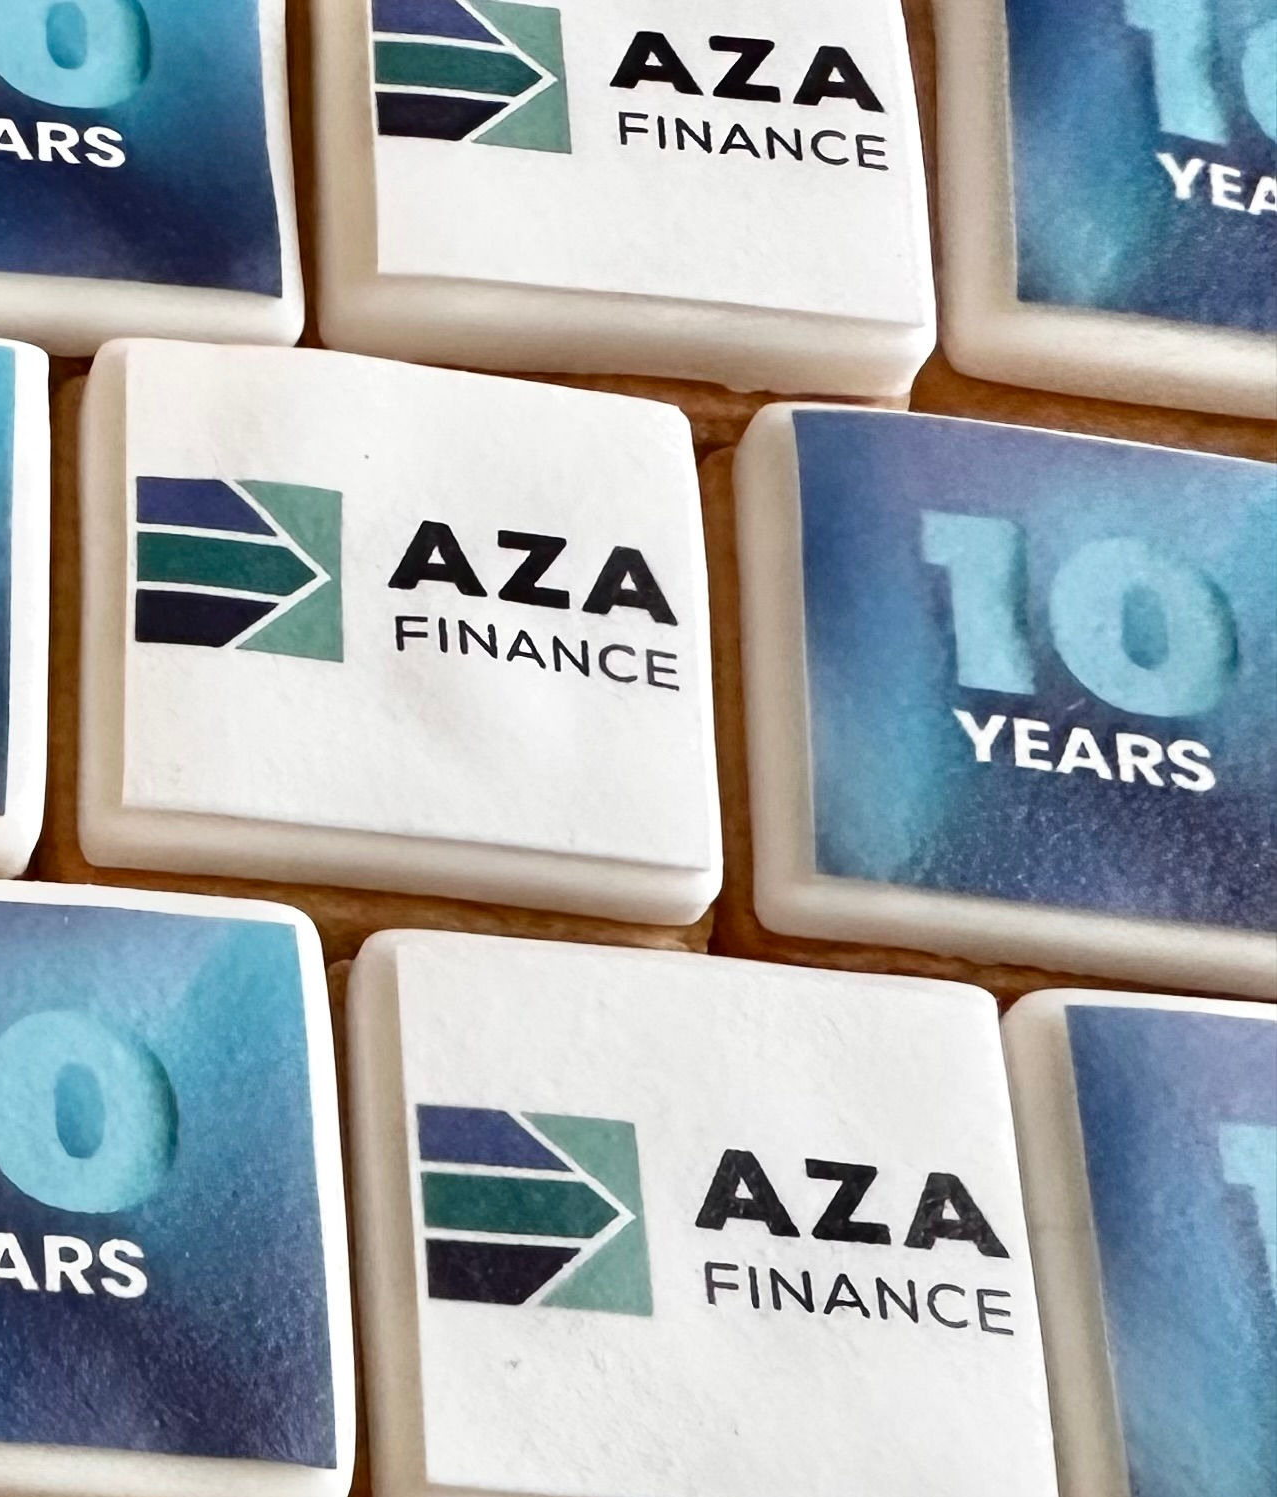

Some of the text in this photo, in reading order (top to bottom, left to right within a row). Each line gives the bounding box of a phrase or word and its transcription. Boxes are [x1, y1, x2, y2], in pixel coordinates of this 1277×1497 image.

[609, 30, 885, 113] AZA
[1124, 0, 1277, 146] 1
[618, 111, 889, 171] FINANCE
[387, 520, 678, 627] AZA
[920, 510, 1236, 718] 10
[394, 615, 680, 691] FINANCE
[954, 709, 1216, 792] YEARS
[694, 1148, 1010, 1259] AZA
[704, 1261, 1014, 1336] FINANCE
